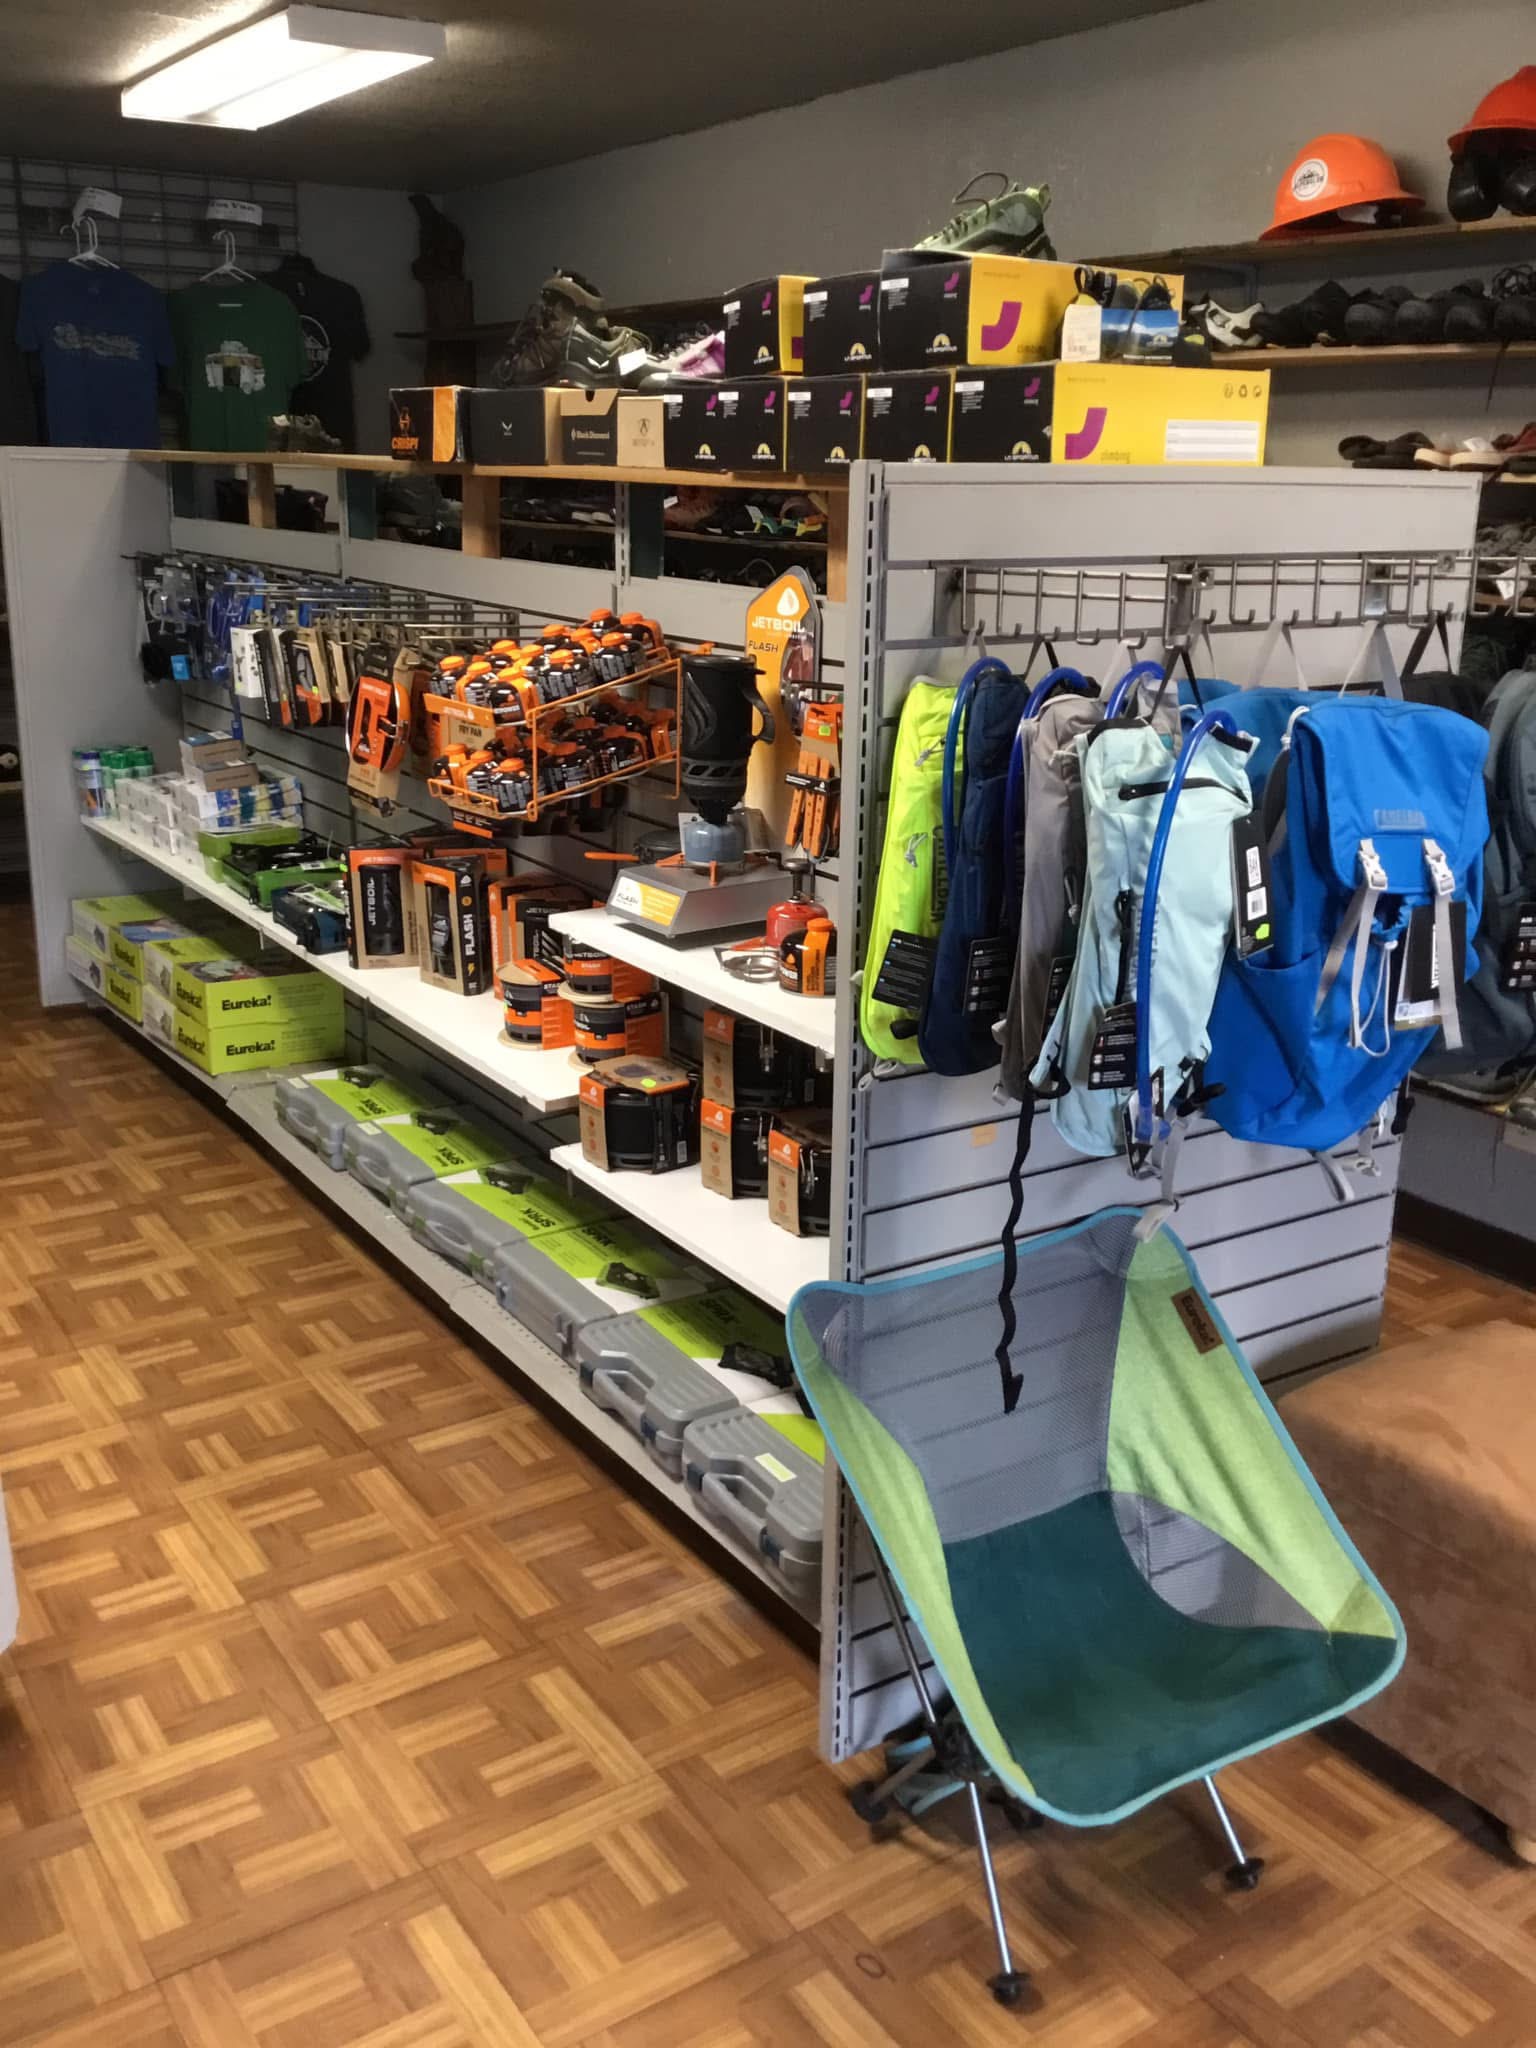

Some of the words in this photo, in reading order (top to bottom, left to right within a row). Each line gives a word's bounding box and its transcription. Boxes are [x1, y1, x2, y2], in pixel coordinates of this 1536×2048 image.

[751, 615, 806, 633] JETBOIL
[748, 639, 779, 653] FLASH
[458, 724, 468, 734] FRY
[469, 727, 482, 737] PAN
[366, 876, 377, 927] JETBOIL
[463, 914, 476, 956] FLASH
[221, 994, 272, 1011] Eureka!
[225, 1039, 276, 1057] Eureka!
[520, 1207, 557, 1228] SPRK
